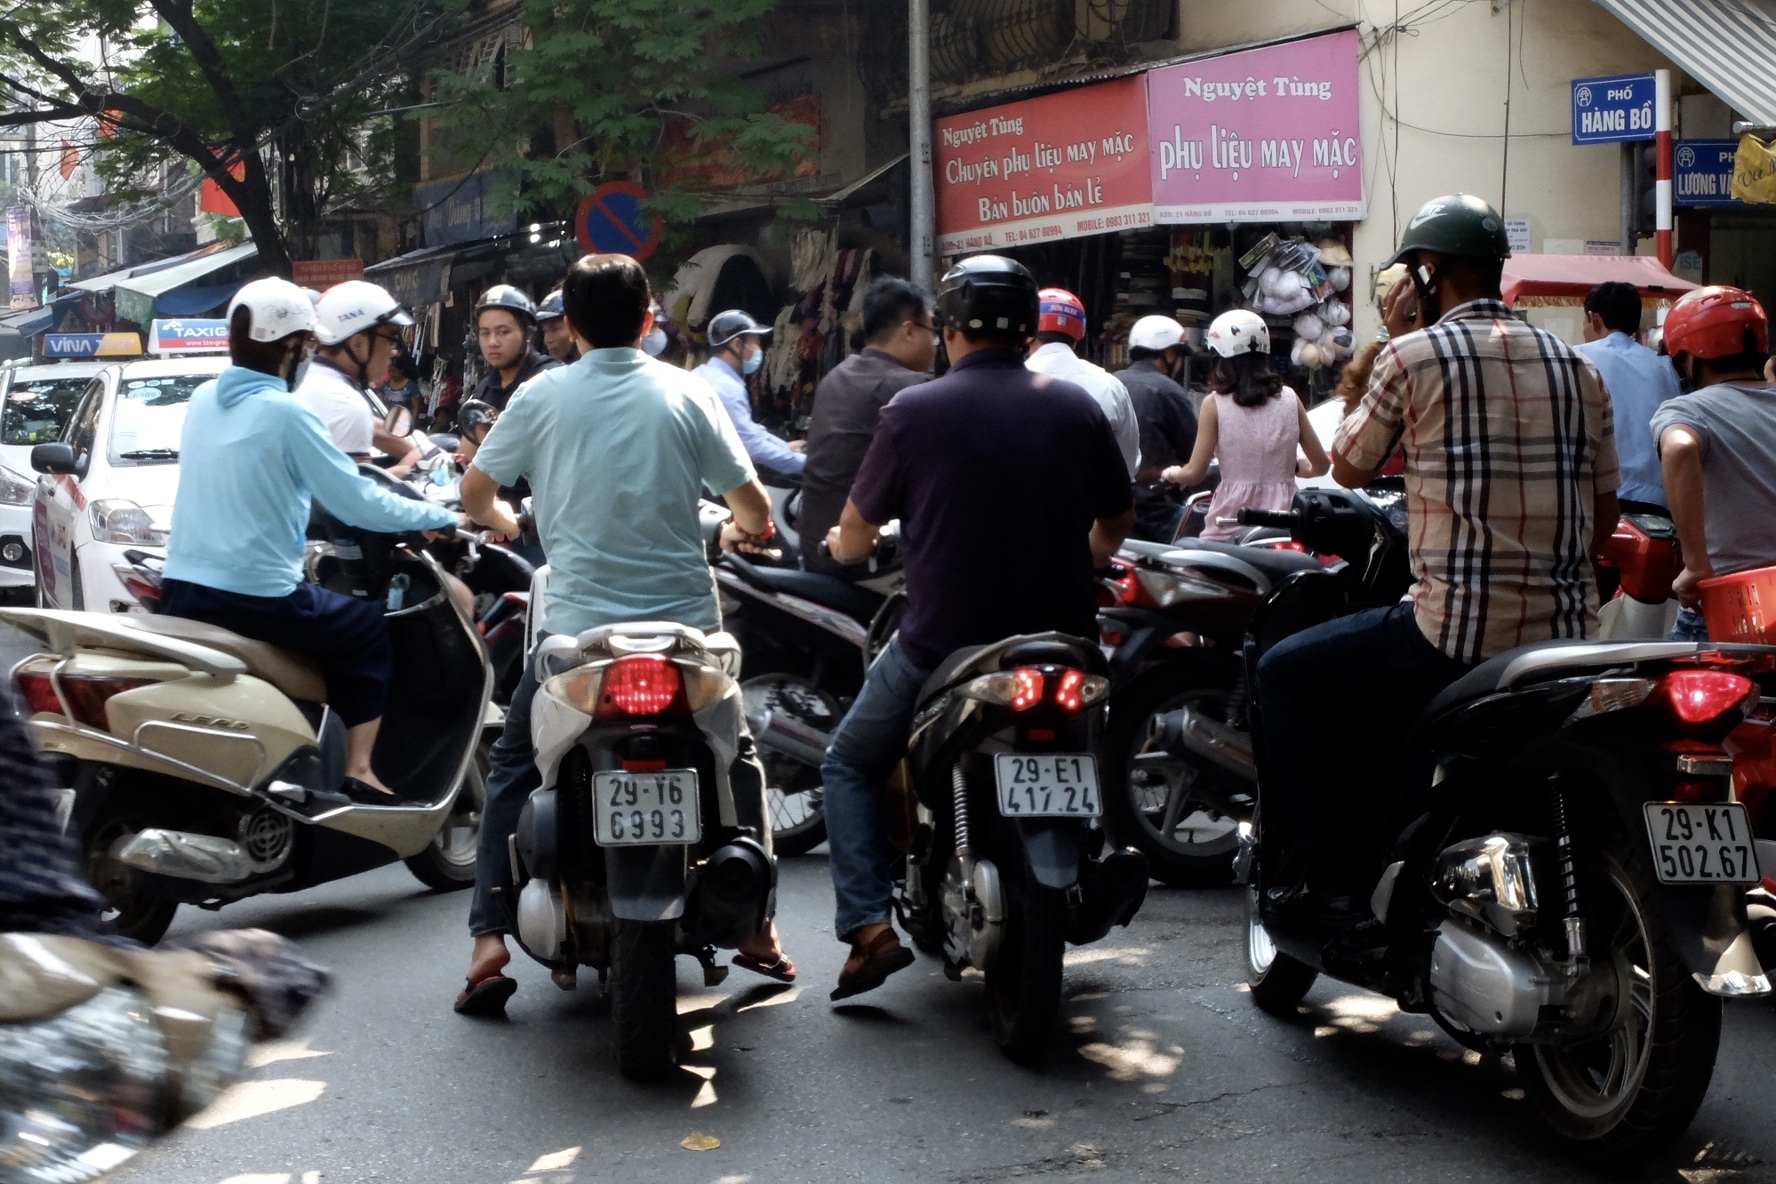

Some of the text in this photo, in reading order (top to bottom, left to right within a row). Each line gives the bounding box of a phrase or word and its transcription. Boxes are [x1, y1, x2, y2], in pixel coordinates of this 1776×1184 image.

[1183, 75, 1332, 101] Nguyệt Tùng
[1607, 84, 1633, 101] PHỐ
[1582, 100, 1652, 133] HÀNG BỒ
[943, 116, 1024, 148] Nguyệt Tùng
[1719, 152, 1736, 163] PH
[1678, 169, 1733, 195] LƯƠNG VĂ
[1004, 231, 1018, 242] TEL:
[1019, 229, 1028, 240] 04
[1028, 227, 1040, 239] 627
[1077, 212, 1151, 232] MOBILE: 0983 311 321
[173, 326, 227, 337] TAXIG
[1008, 786, 1095, 812] 417.24
[610, 809, 684, 839] 6993
[1660, 844, 1748, 878] 502.67
